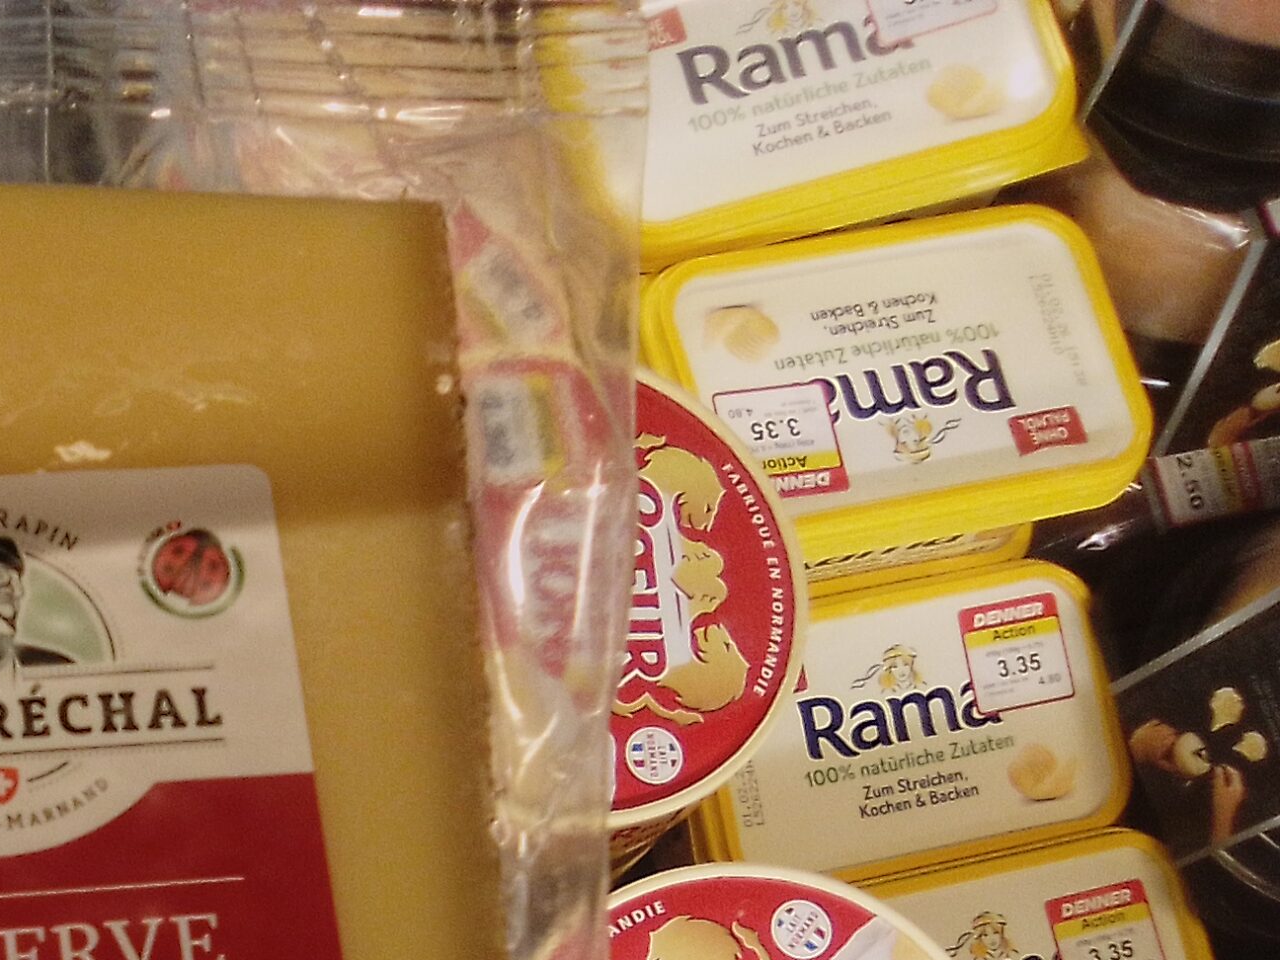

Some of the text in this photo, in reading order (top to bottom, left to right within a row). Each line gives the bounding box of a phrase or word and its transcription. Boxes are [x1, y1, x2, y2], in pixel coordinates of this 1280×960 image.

[687, 56, 933, 134] 100% natürliche Zutaten
[752, 132, 814, 156] Kochen
[833, 109, 892, 134] Backen
[755, 119, 792, 138] Zum
[810, 303, 864, 323] Backen
[882, 291, 938, 310] Kochen
[902, 309, 936, 325] Zum
[773, 321, 1001, 374] 100% natürliche Zutaten
[750, 417, 802, 442] 3.35
[773, 471, 831, 493] DENN
[721, 463, 785, 697] FABRIQUE EN NORMANDIE
[996, 653, 1042, 678] 3.35
[804, 734, 1015, 788] 100% natürliche Zutaten
[862, 769, 969, 801] Zum Streichen,
[859, 796, 912, 820] Kochen
[931, 784, 979, 807] Backen
[608, 900, 667, 938] ANDIE
